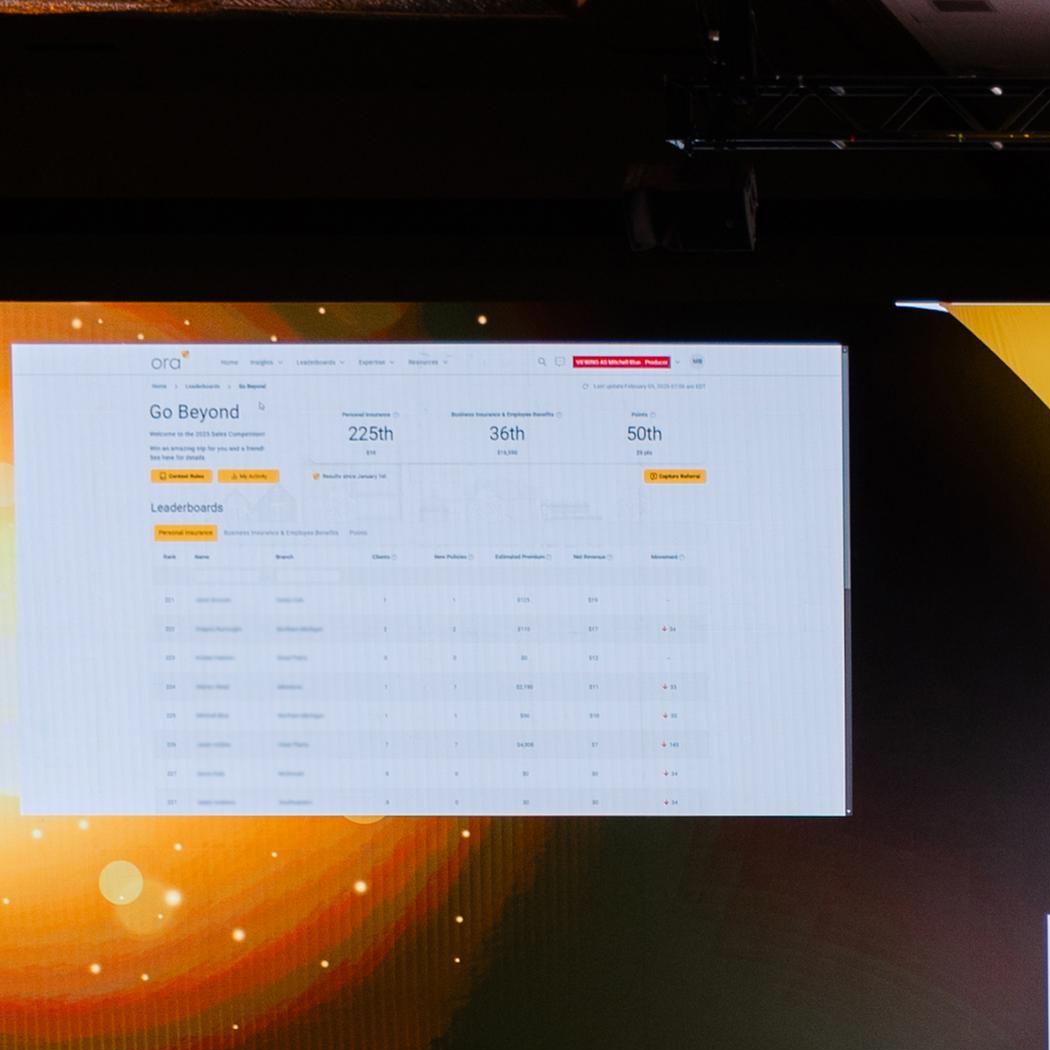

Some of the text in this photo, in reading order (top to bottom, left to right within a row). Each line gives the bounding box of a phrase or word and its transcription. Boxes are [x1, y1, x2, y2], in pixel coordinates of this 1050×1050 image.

[150, 357, 181, 370] ora
[250, 359, 273, 367] Insights
[358, 359, 386, 367] Expertise
[149, 403, 240, 423] Go Beyond
[348, 425, 394, 441] 225th
[489, 425, 525, 441] 36th
[627, 425, 662, 441] 50th
[150, 501, 224, 513] Leaderboards
